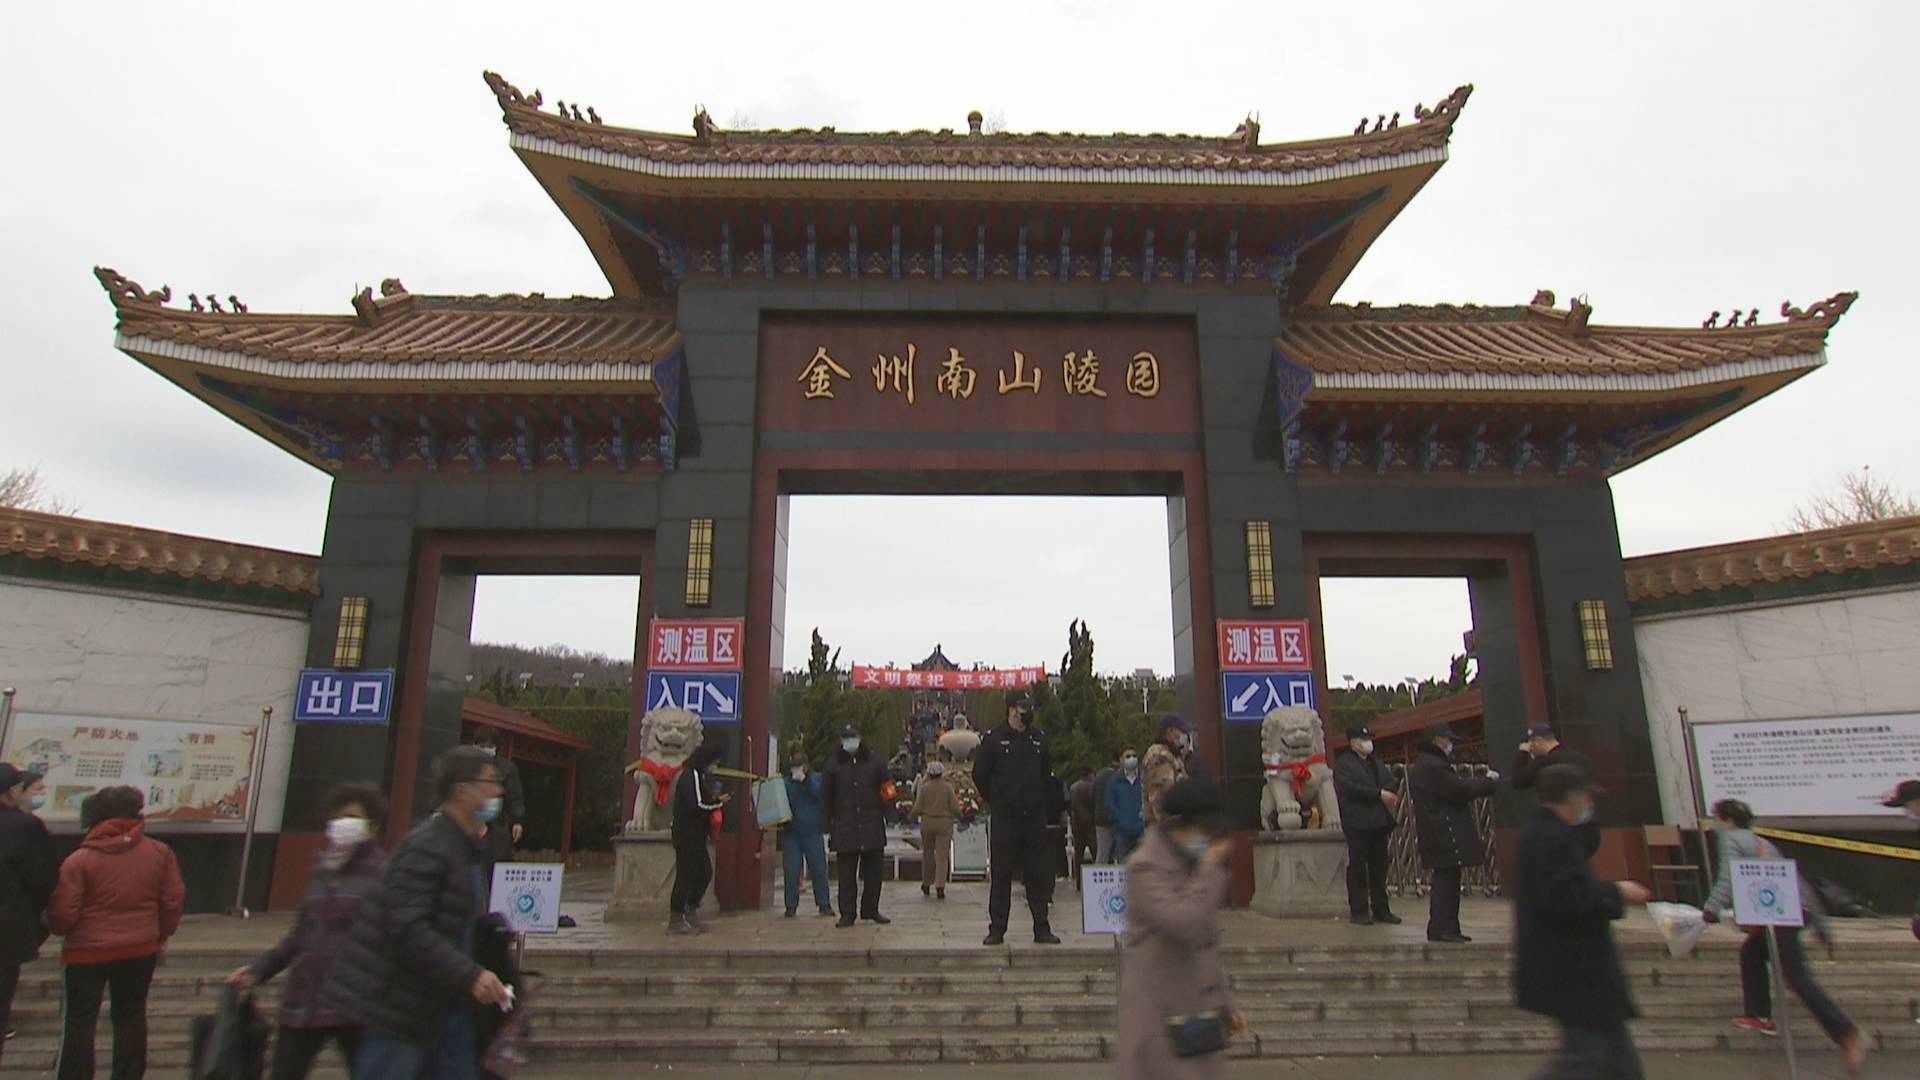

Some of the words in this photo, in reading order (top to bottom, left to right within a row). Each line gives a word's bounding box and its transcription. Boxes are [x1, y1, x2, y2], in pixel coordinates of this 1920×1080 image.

[797, 342, 1162, 405] 金州南山陵园
[657, 626, 736, 665] 测温区
[1226, 627, 1304, 663] 测温区
[305, 676, 383, 716] 出口
[655, 677, 705, 713] 入口
[863, 670, 945, 687] 文明祭祀
[957, 670, 1038, 688] 平安清明
[1262, 677, 1310, 713] 入口
